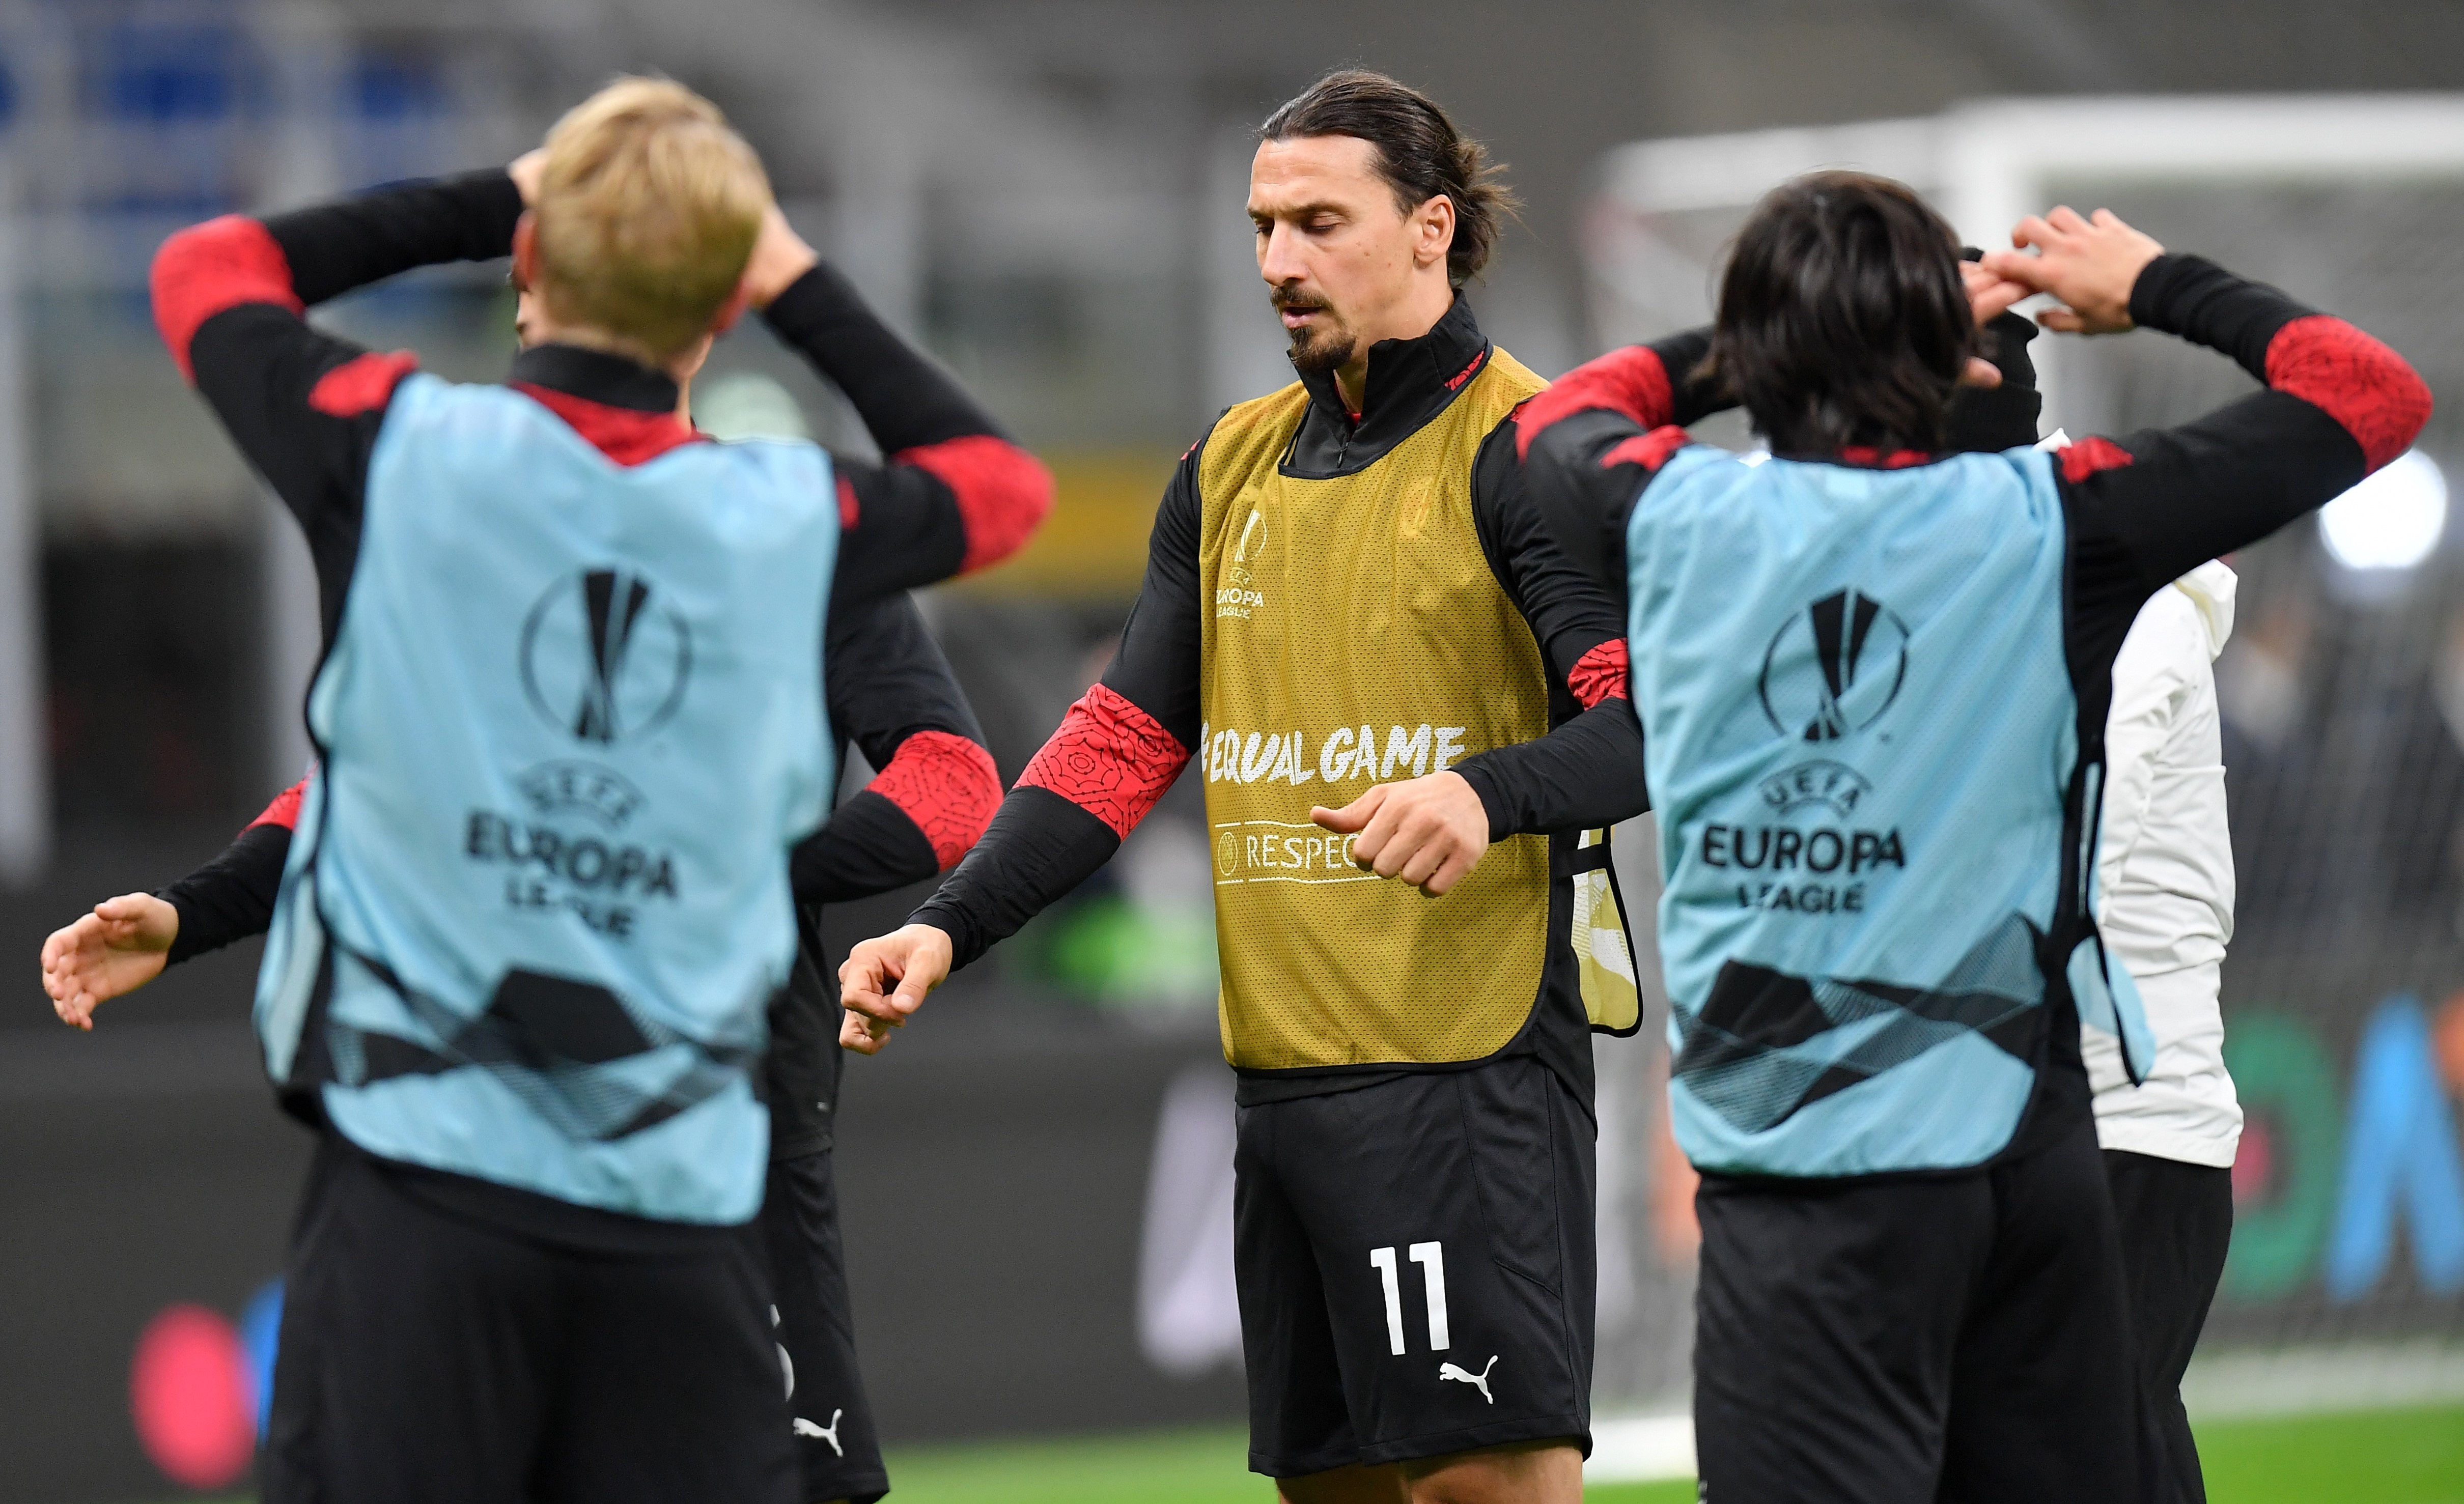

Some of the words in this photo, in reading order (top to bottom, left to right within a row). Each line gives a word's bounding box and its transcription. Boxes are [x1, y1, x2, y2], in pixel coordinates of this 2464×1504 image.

[466, 810, 679, 901] EUROPA
[1246, 833, 1360, 870] RESPEC
[1702, 825, 1907, 875] EUROPA
[1370, 1241, 1450, 1355] 11
